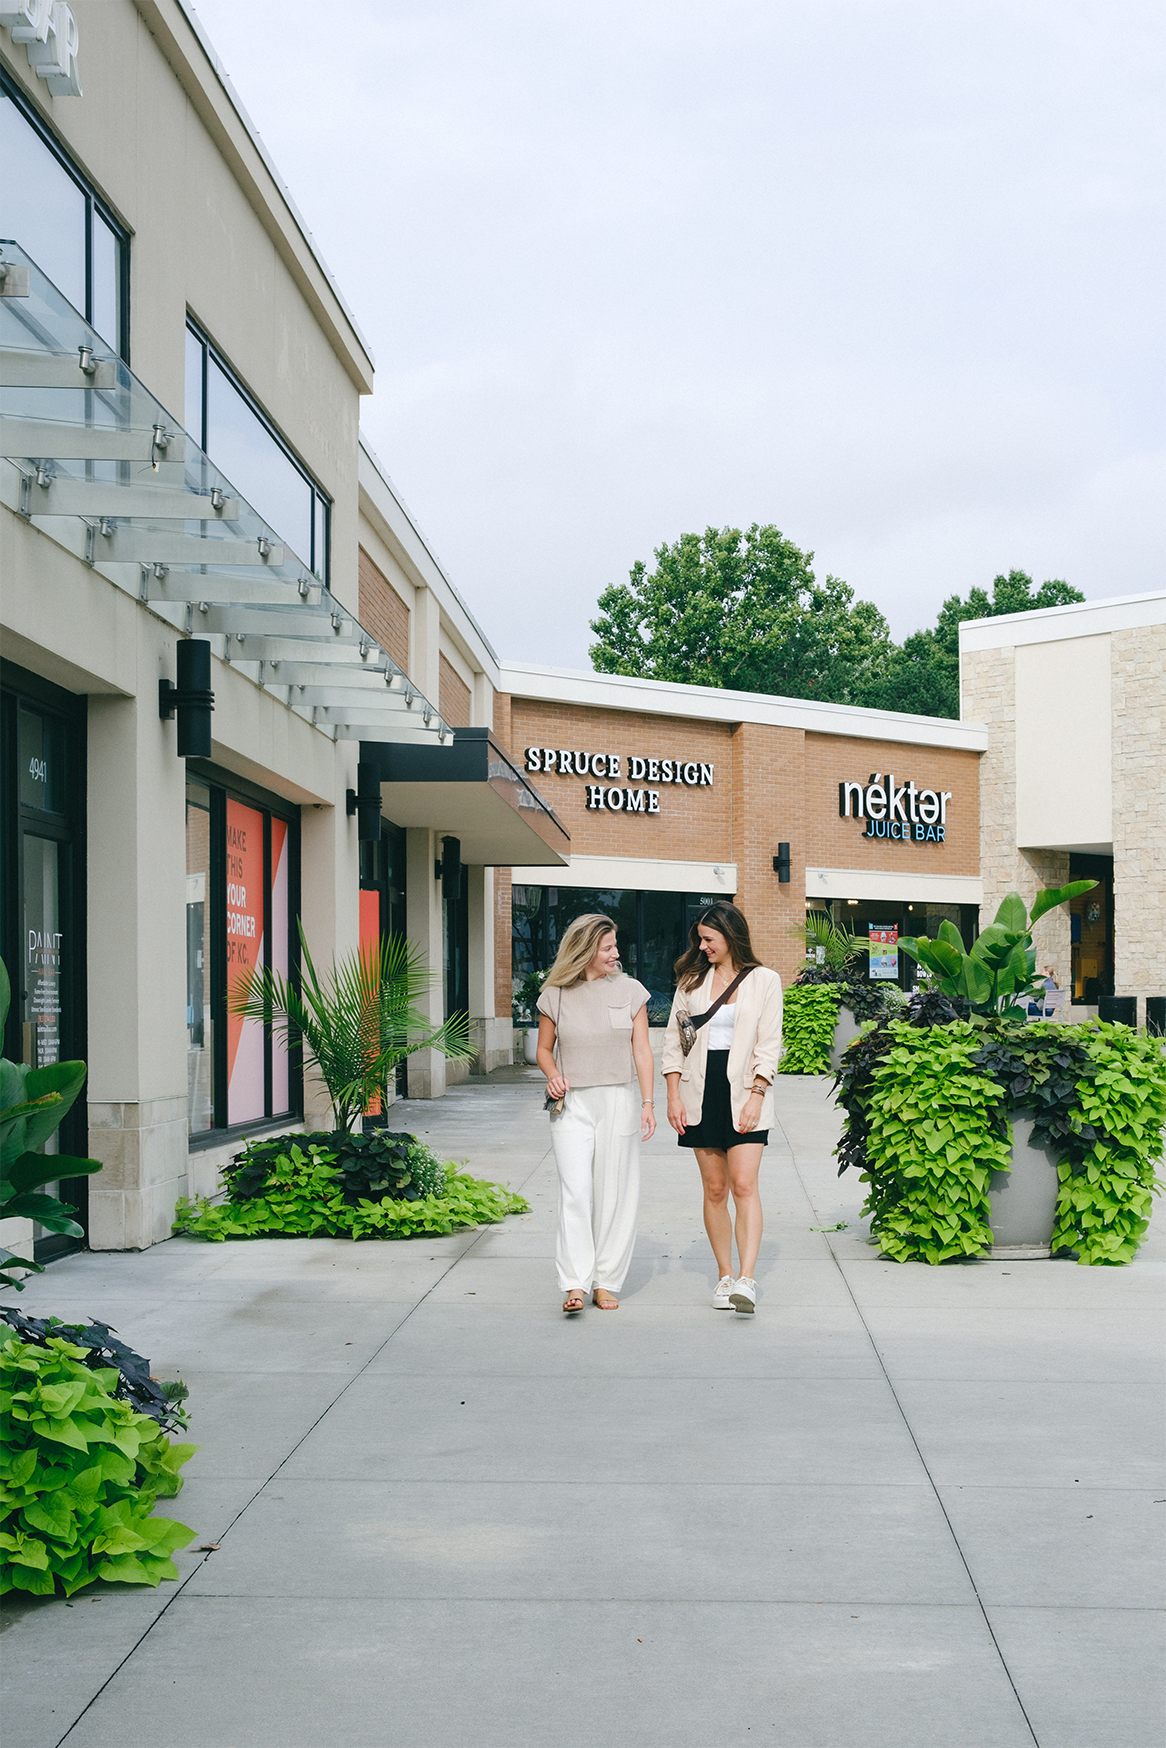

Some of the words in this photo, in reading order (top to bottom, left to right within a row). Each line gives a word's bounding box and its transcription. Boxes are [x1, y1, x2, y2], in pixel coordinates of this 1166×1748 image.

[29, 757, 47, 783] 4941
[526, 747, 621, 778] SPRUCE
[629, 757, 714, 785] DESIGN
[586, 786, 660, 813] HOME
[226, 825, 247, 852] MAKE
[865, 820, 910, 839] JUICE
[915, 824, 946, 842] BAR
[226, 853, 243, 879] THIS
[227, 883, 246, 908] YOUR
[227, 911, 256, 938] CORNER
[28, 929, 63, 965] PAINT
[227, 940, 236, 962] OF
